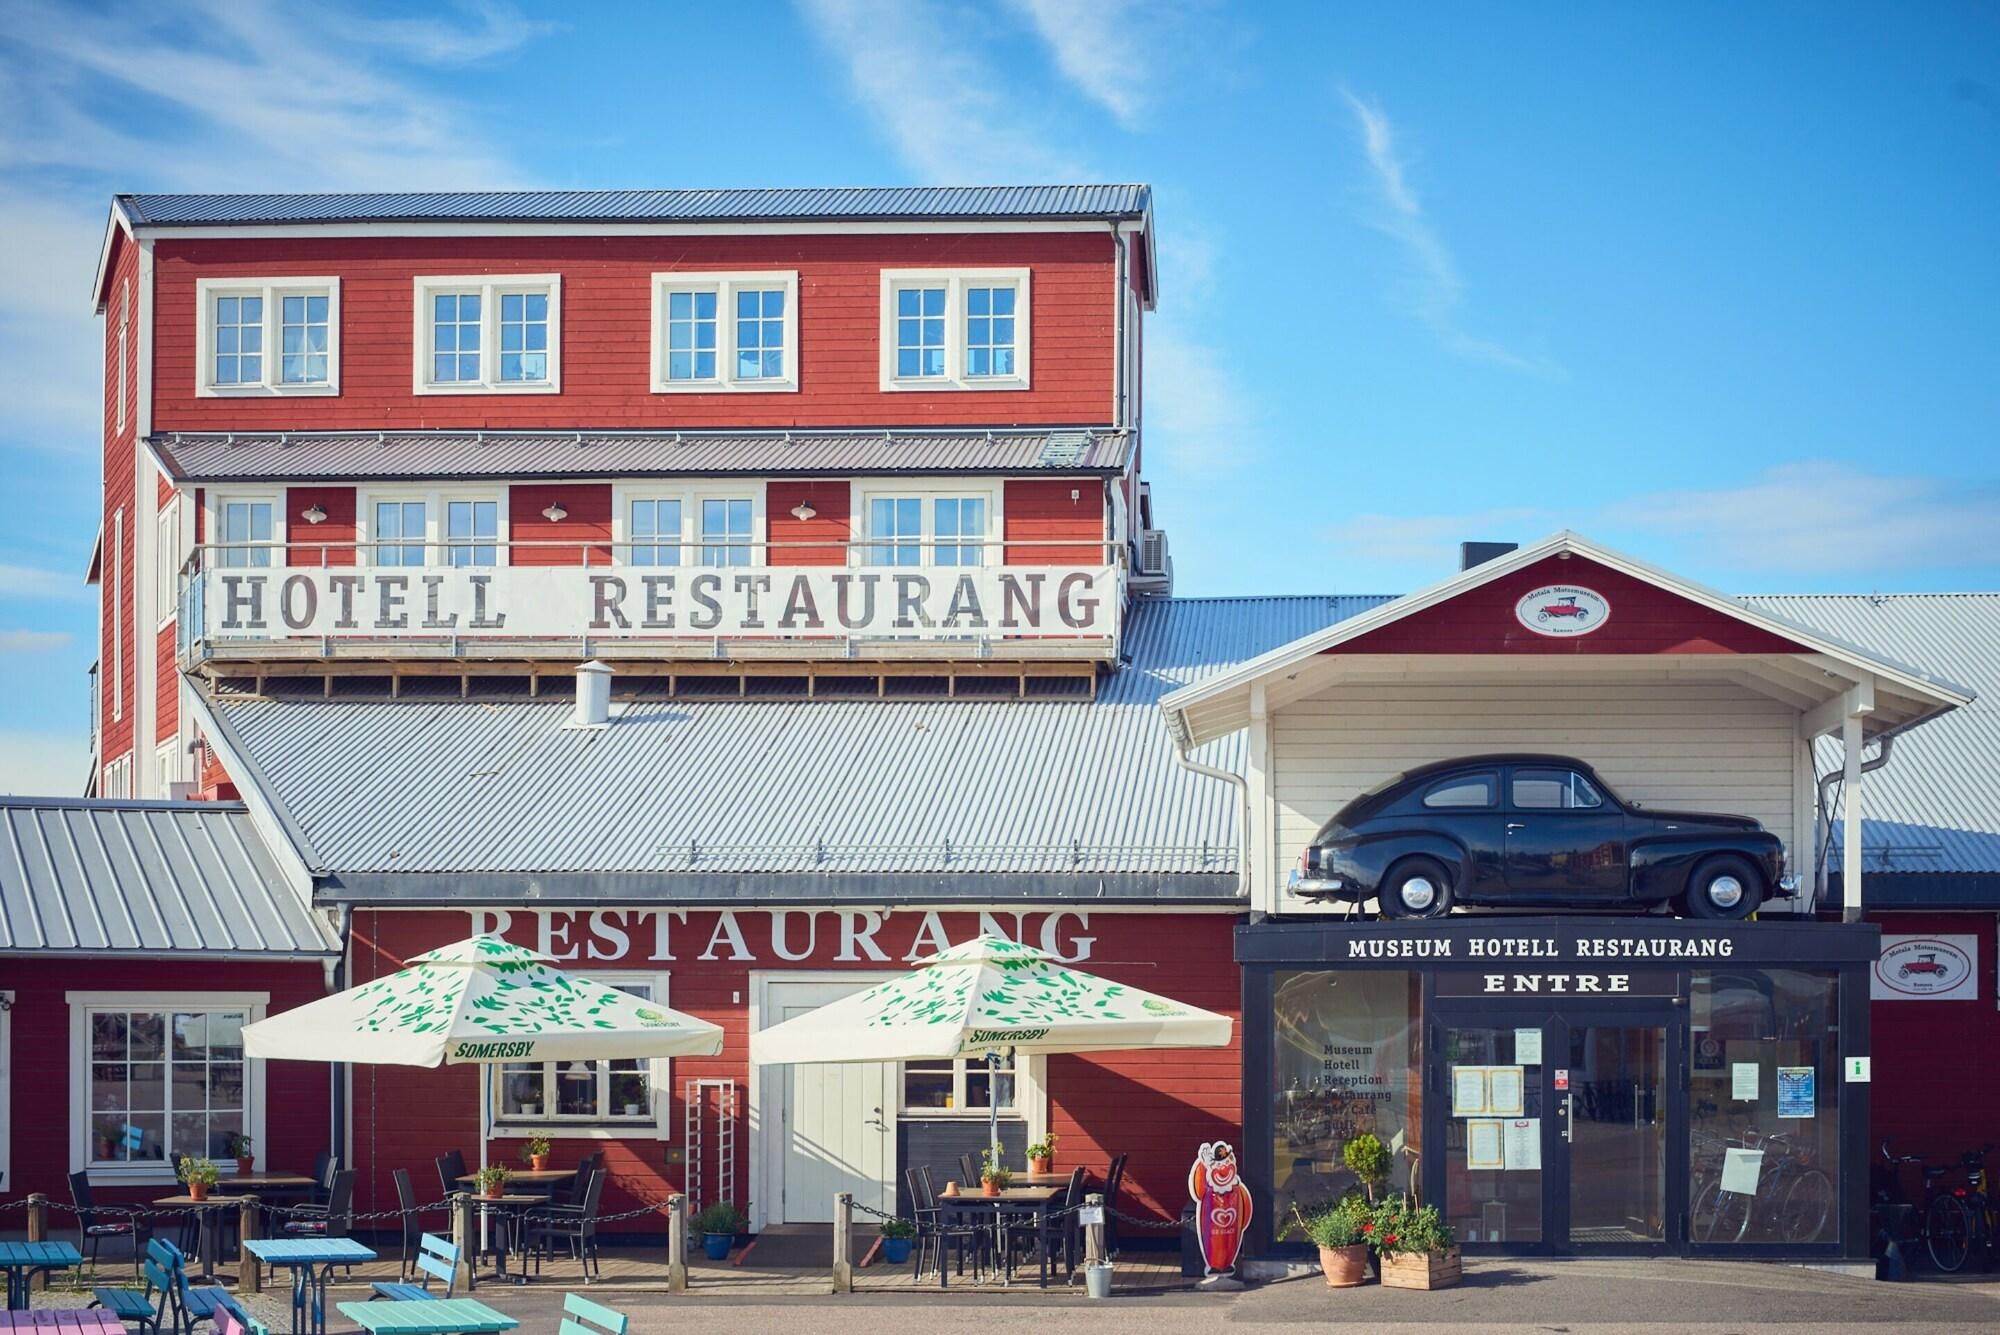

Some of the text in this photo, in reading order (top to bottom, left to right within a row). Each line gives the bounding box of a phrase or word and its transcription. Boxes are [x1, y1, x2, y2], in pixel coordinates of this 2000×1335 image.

[1527, 589, 1551, 600] Motala
[222, 573, 1100, 630] HOTELL RESTAURANG
[1348, 938, 1734, 958] MUSEUM HOTELL RESTAURANG
[1483, 974, 1630, 993] ENTRE
[1324, 1044, 1373, 1055] Museum
[1324, 1059, 1360, 1071] Hotell
[1324, 1074, 1383, 1087] Reception
[1324, 1090, 1392, 1102] Restaurang
